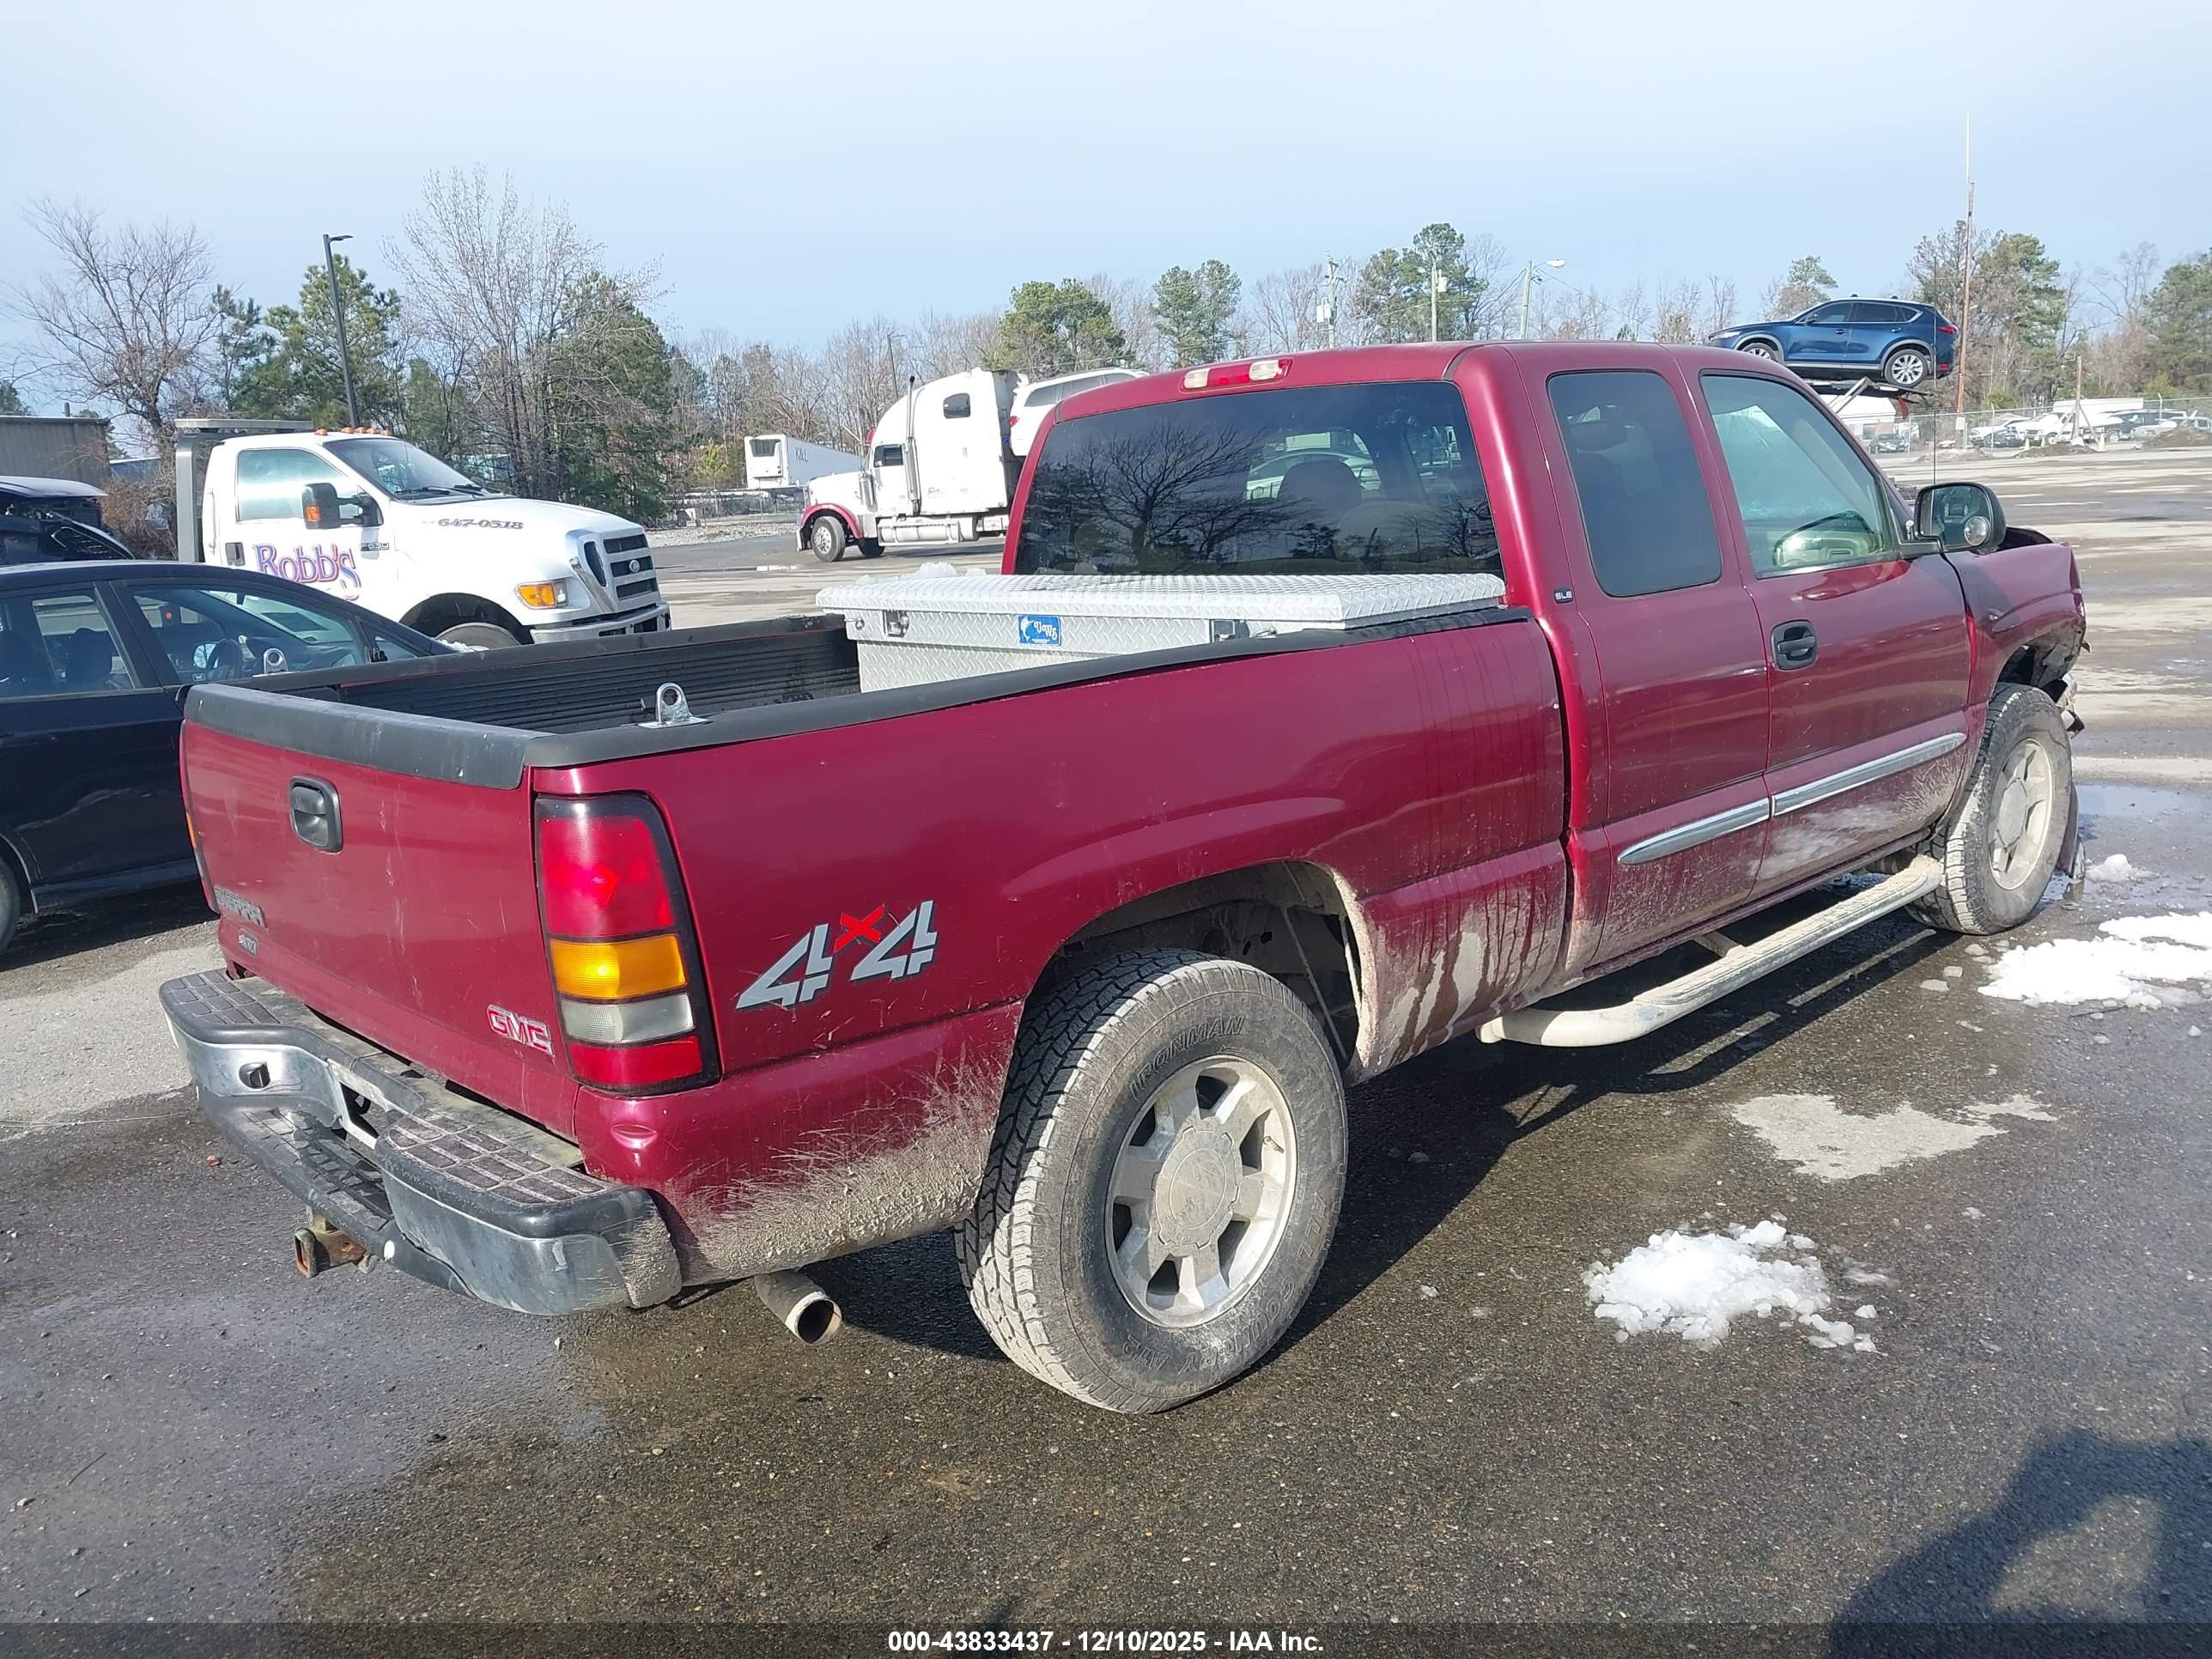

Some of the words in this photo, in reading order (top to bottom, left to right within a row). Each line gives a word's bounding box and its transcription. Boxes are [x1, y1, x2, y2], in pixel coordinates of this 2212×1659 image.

[438, 518, 524, 530] 647-0518
[1554, 591, 1572, 600] SLE
[486, 1003, 556, 1059] GMC
[1129, 1016, 1244, 1101] IRONMAN
